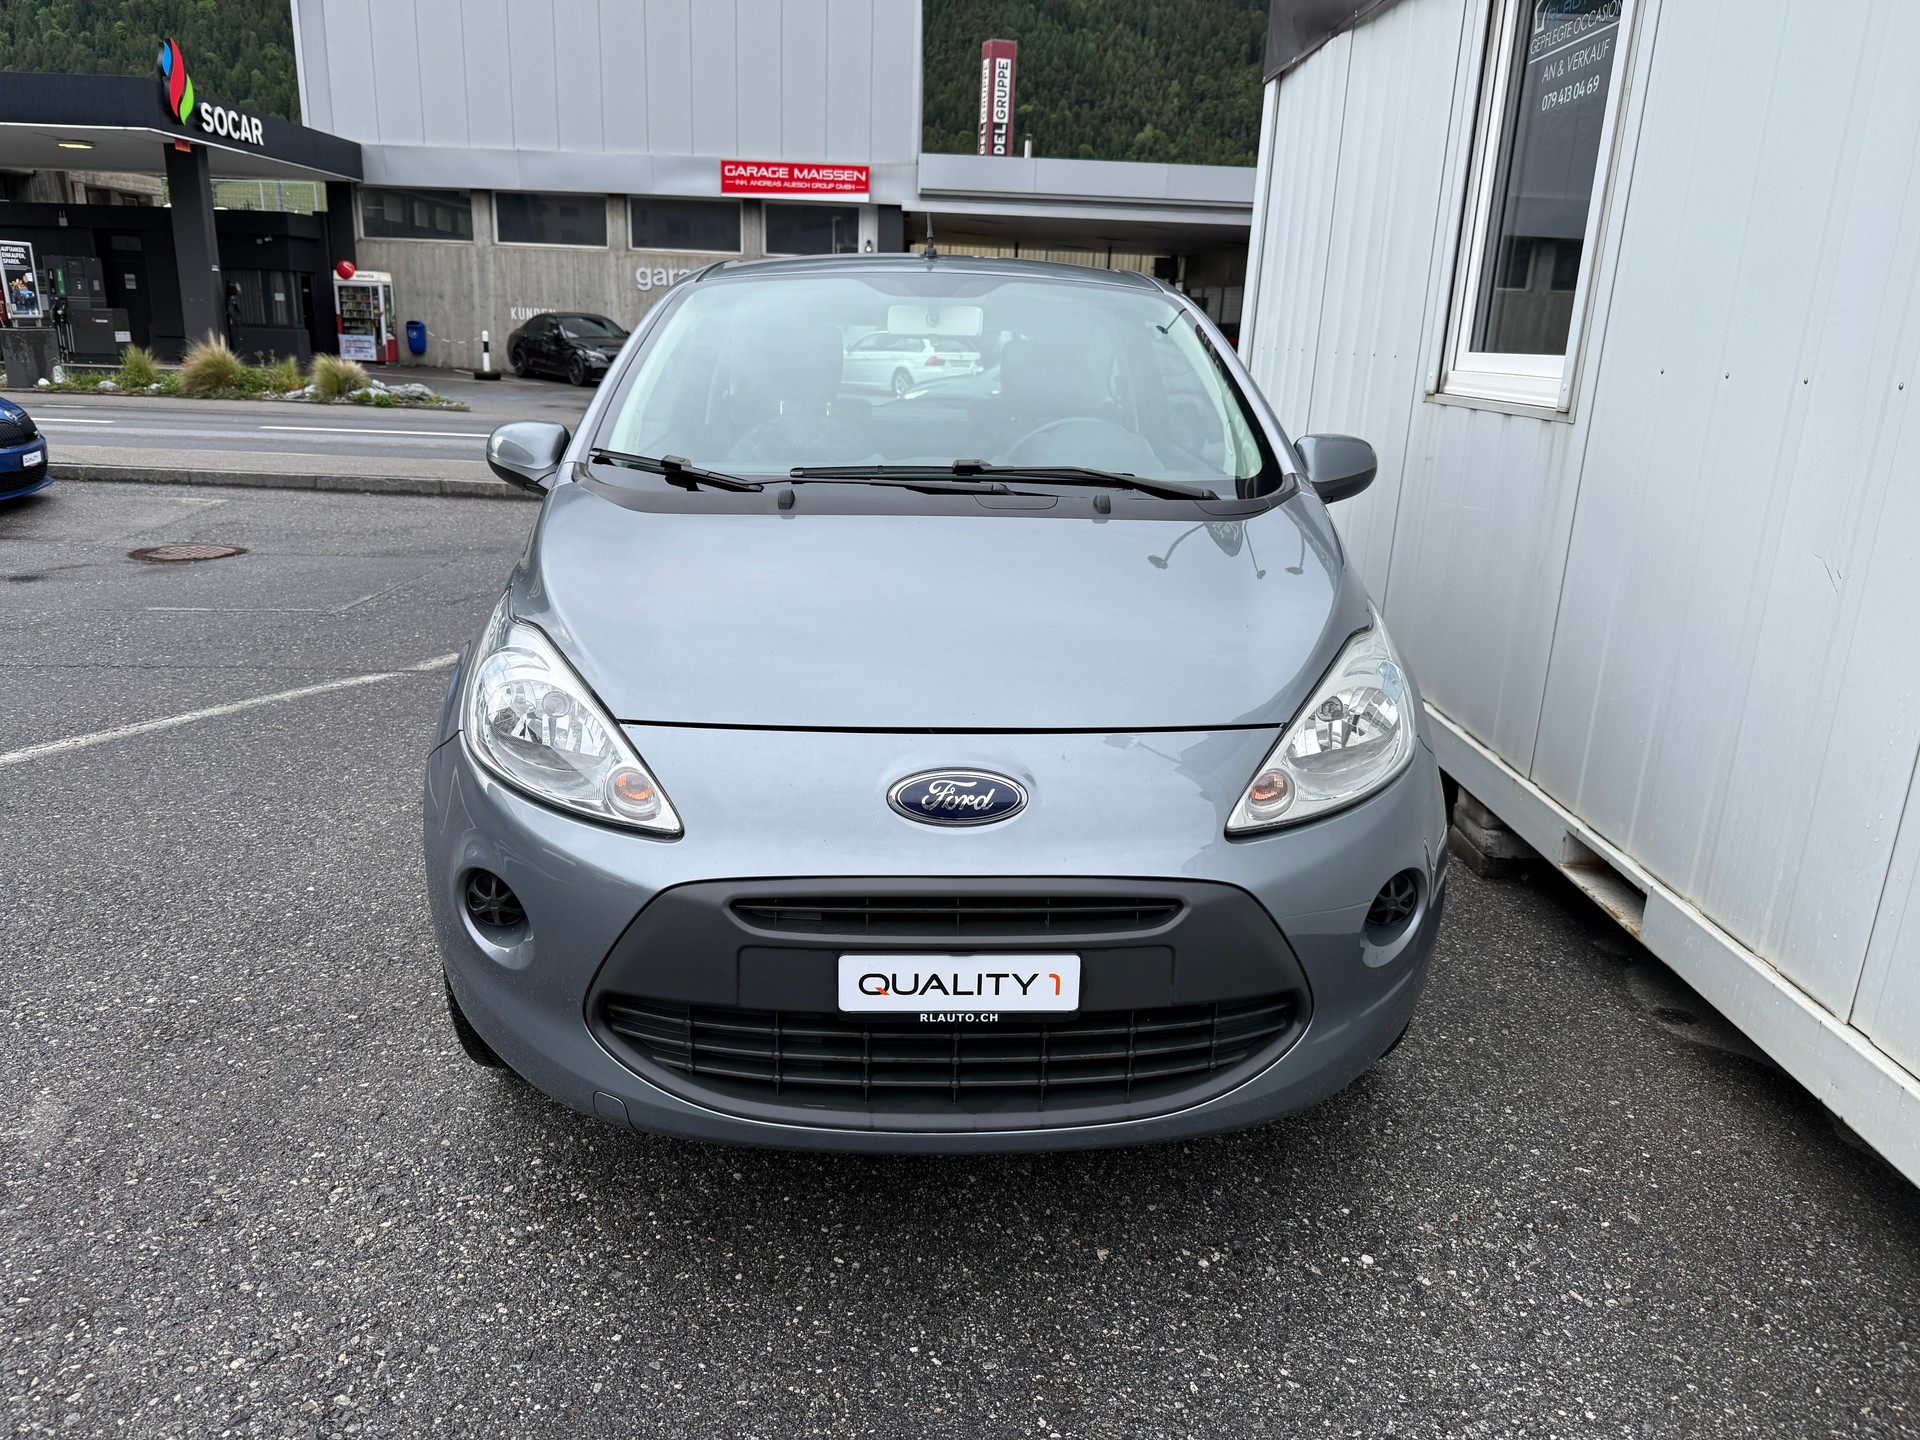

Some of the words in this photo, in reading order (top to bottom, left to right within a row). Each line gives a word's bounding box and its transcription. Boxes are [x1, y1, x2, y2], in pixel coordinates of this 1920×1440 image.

[1530, 21, 1573, 54] GEPFLEGTE
[1542, 62, 1557, 84] AN
[1557, 59, 1564, 77] &
[1567, 39, 1610, 72] VERKAUF
[996, 61, 1008, 120] GRUPPE
[1541, 91, 1558, 112] 079
[1558, 84, 1573, 105] 413
[1573, 80, 1585, 100] 04
[1586, 74, 1600, 95] 69
[200, 102, 265, 146] SOCAR
[724, 165, 789, 179] GARAGE
[793, 168, 866, 182] MAISSEN
[811, 182, 834, 190] GROUP
[921, 779, 996, 811] Ford
[858, 973, 1040, 996] QUALITY
[1048, 973, 1061, 996] 1
[919, 1013, 999, 1023] RLAUTO.CH
